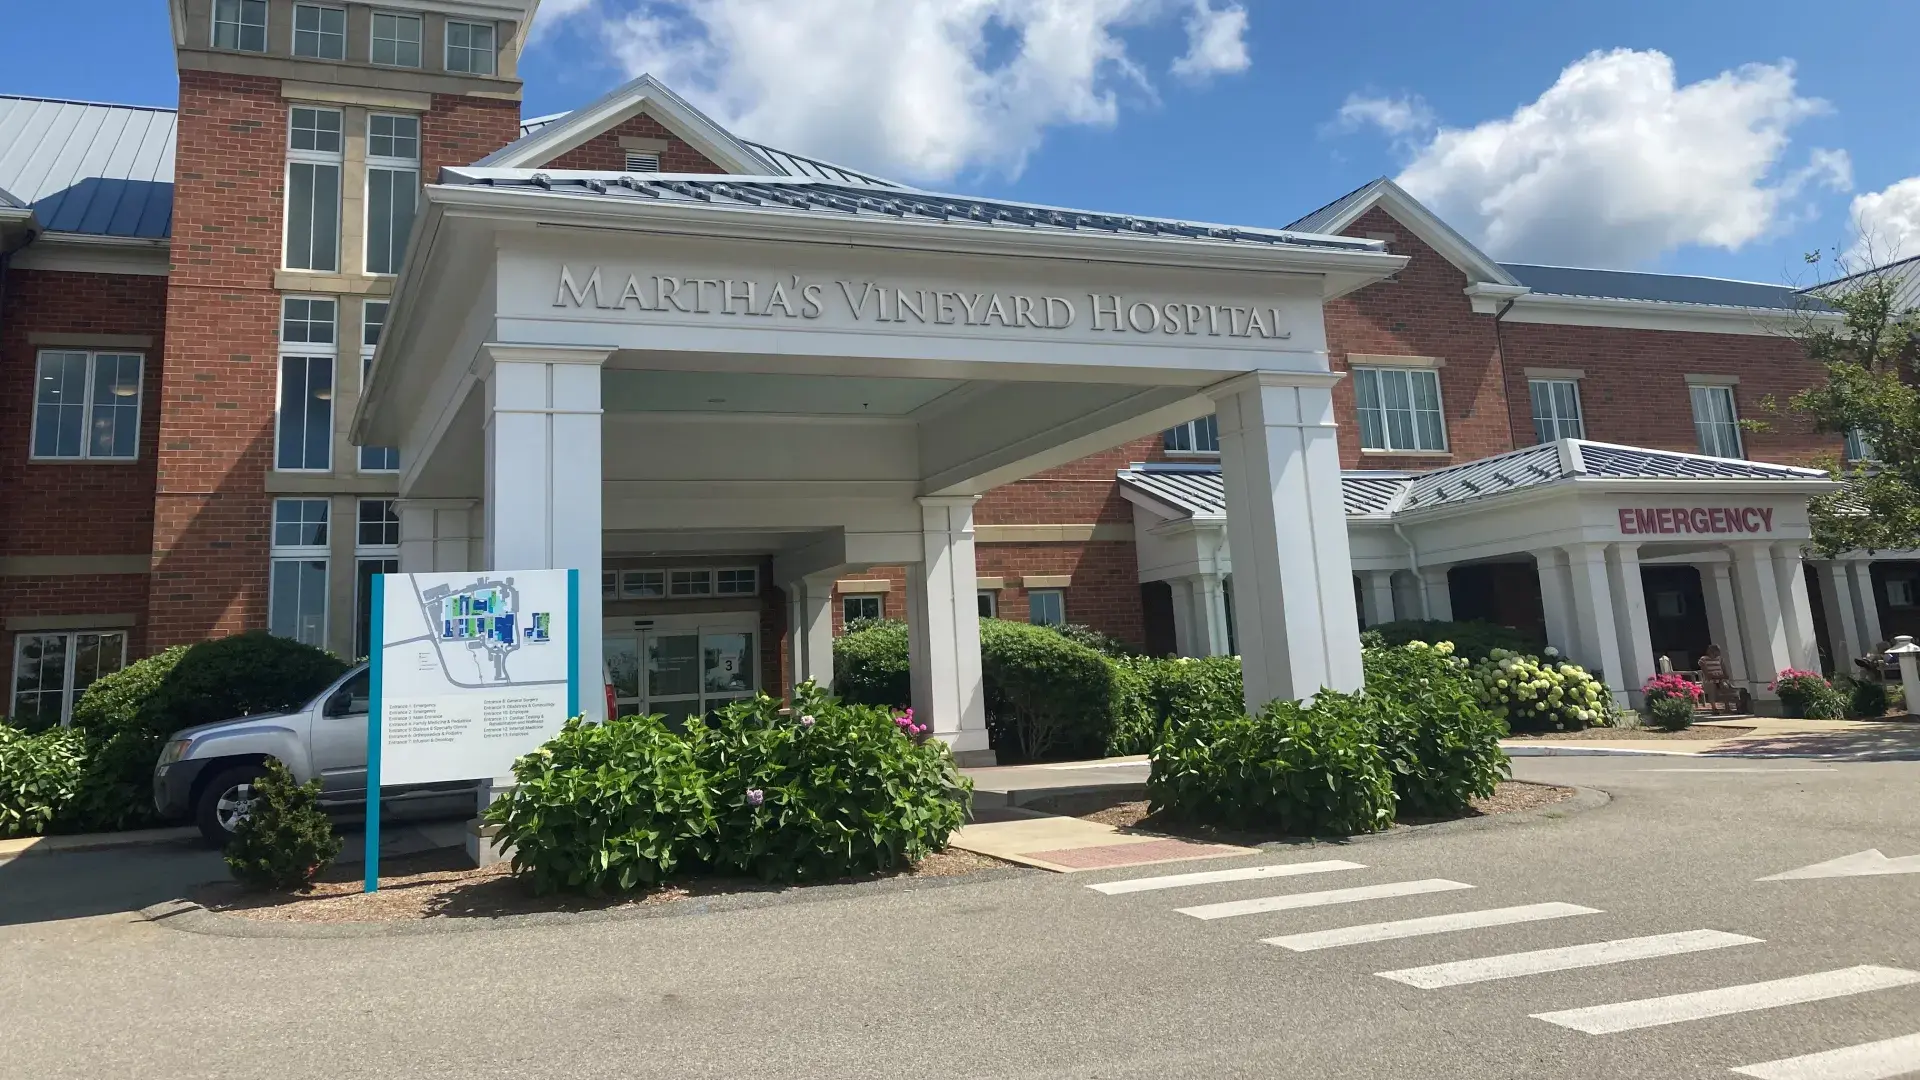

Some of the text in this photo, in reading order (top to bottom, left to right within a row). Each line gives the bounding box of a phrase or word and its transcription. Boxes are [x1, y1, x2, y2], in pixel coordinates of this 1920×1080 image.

[553, 263, 1291, 339] MARTHA'S VINEYARD HOSPITAL
[1618, 507, 1774, 534] EMERGENCY
[725, 660, 733, 671] 3
